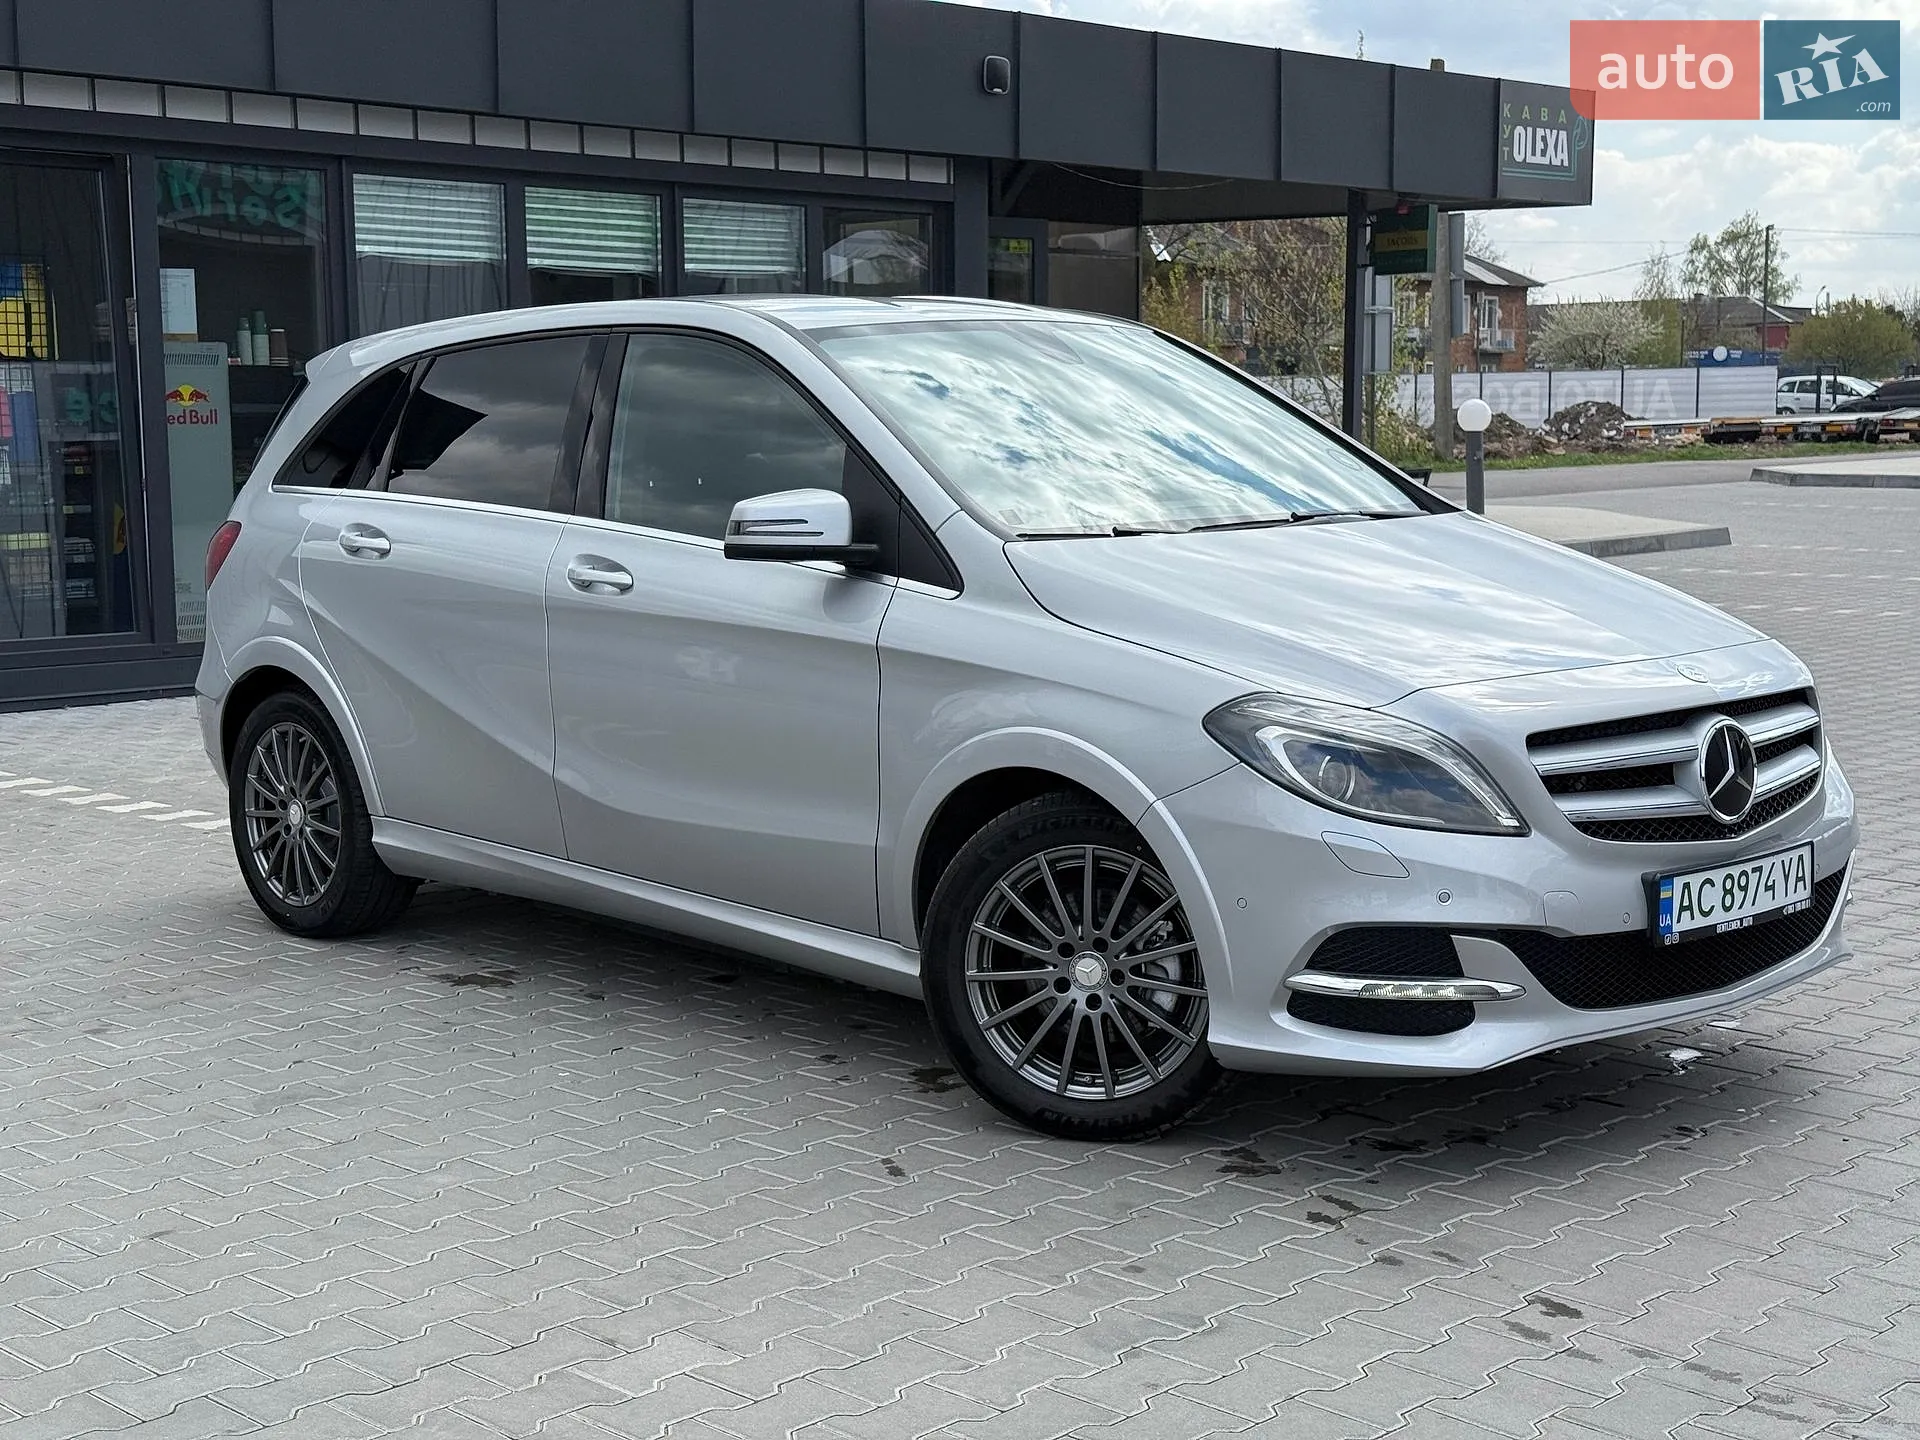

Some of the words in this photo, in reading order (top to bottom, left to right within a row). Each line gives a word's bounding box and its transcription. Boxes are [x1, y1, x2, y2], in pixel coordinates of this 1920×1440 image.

[1513, 125, 1569, 167] OLEXA
[167, 408, 187, 425] ed
[189, 408, 218, 425] Bull
[1676, 877, 1716, 924] AC
[1721, 861, 1777, 913] 8974
[1781, 853, 1808, 898] YA
[1659, 914, 1672, 927] UA
